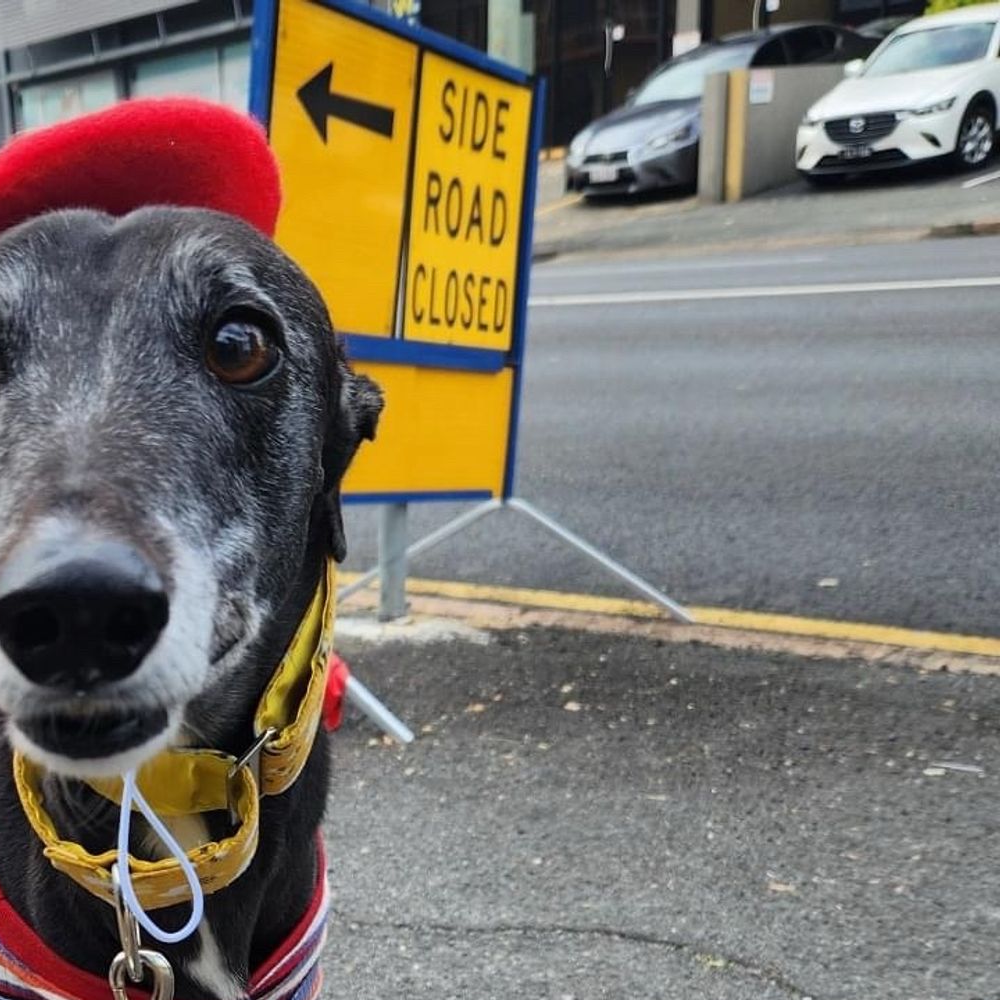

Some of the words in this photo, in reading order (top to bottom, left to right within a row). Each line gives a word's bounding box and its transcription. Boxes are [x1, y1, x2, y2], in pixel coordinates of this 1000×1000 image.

[439, 80, 510, 161] SIDE
[424, 170, 508, 247] ROAD
[411, 263, 508, 333] CLOSED
